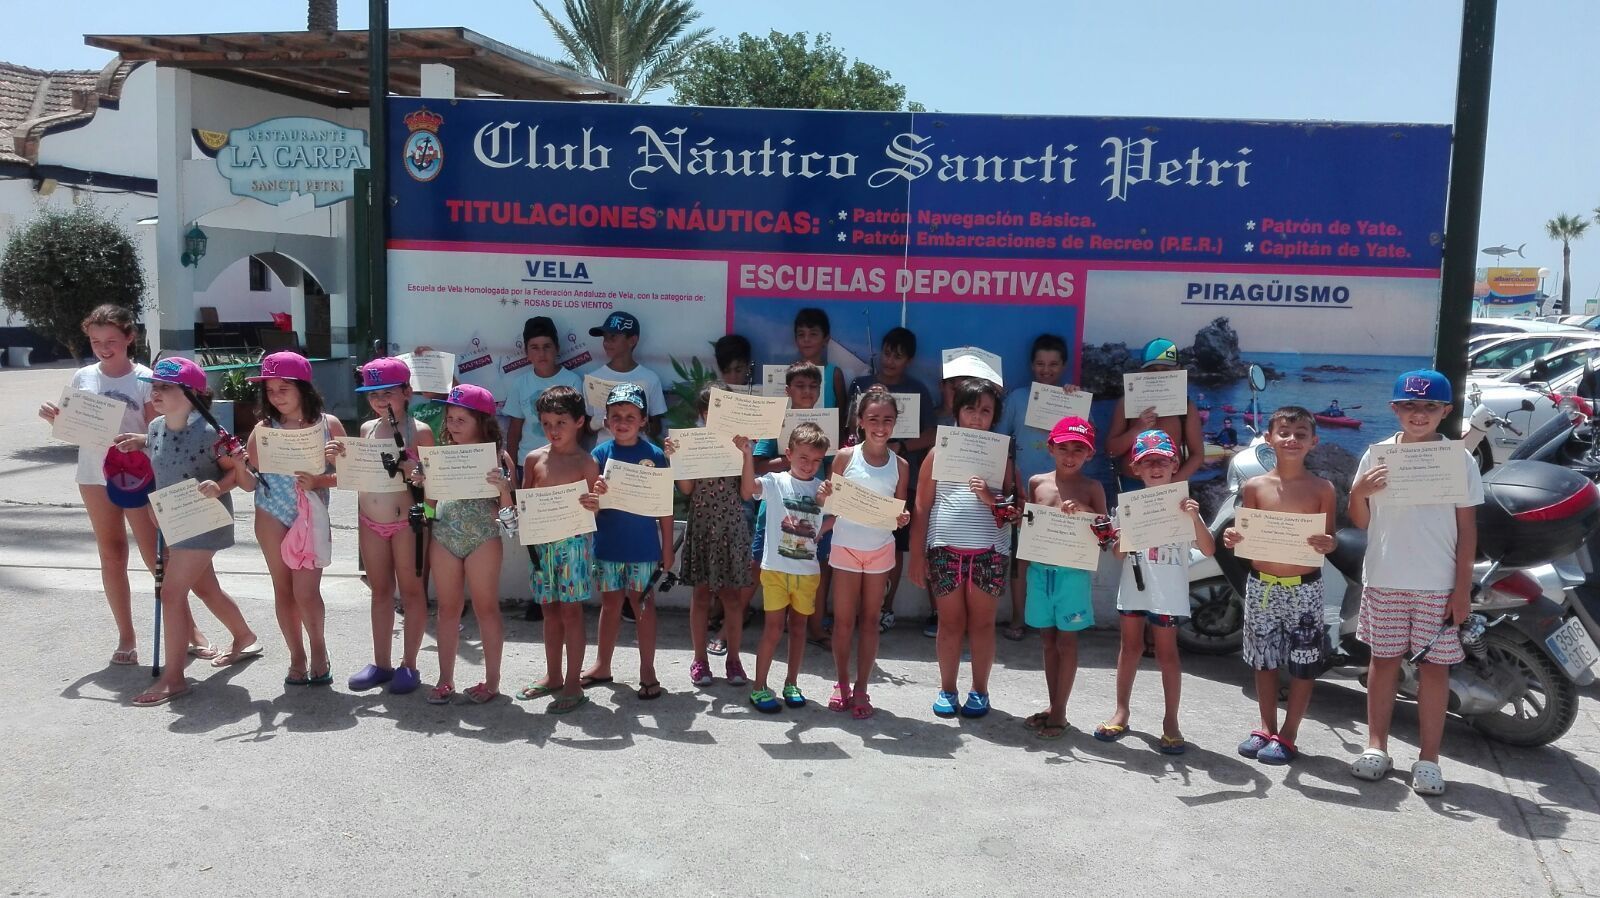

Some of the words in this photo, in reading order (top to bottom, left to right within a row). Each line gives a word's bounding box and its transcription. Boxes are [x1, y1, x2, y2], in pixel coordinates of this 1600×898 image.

[248, 130, 346, 142] RESTAURANTE
[230, 145, 267, 168] LA
[273, 145, 366, 168] CARPA
[474, 121, 612, 171] Club
[629, 125, 859, 189] Náutico
[868, 133, 1078, 188] Sancti
[1100, 137, 1252, 201] Petri
[251, 179, 300, 192] SANCTI
[305, 179, 344, 192] PETRI
[446, 200, 657, 230] TITULACIONES
[666, 202, 820, 234] NÁUTICAS:
[853, 208, 912, 224] Patrón
[918, 209, 1023, 229] Navegación
[1029, 211, 1096, 228] Básica.
[1261, 218, 1322, 234] Patrón
[1328, 220, 1350, 235] de
[1357, 221, 1402, 236] Yate.
[852, 229, 910, 245] Patrón
[917, 231, 1056, 248] Embarcaciones
[1062, 235, 1083, 249] de
[1090, 235, 1153, 250] Recreo
[1160, 236, 1223, 255] (P.E.R.)
[1260, 239, 1332, 258] Capitán
[1338, 242, 1360, 257] de
[1366, 242, 1411, 258] Yate.
[525, 260, 589, 279] VELA
[740, 264, 886, 293] ESCUELAS
[895, 269, 1074, 297] DEPORTIVAS
[407, 284, 436, 292] Escuela
[437, 284, 446, 292] de
[448, 285, 463, 293] Vela
[464, 285, 509, 296] Homologada
[511, 288, 523, 297] por
[524, 287, 532, 295] la
[574, 289, 606, 298] Andaluza
[637, 292, 650, 300] con
[1187, 280, 1350, 303] PIRAGÜISMO
[524, 299, 550, 307] ROSAS
[552, 300, 563, 308] DE
[581, 301, 613, 309] VIENTOS
[1556, 620, 1585, 651] 3508
[1291, 655, 1320, 665] WARS
[1293, 648, 1319, 657] STAR
[1568, 643, 1592, 670] GTG
